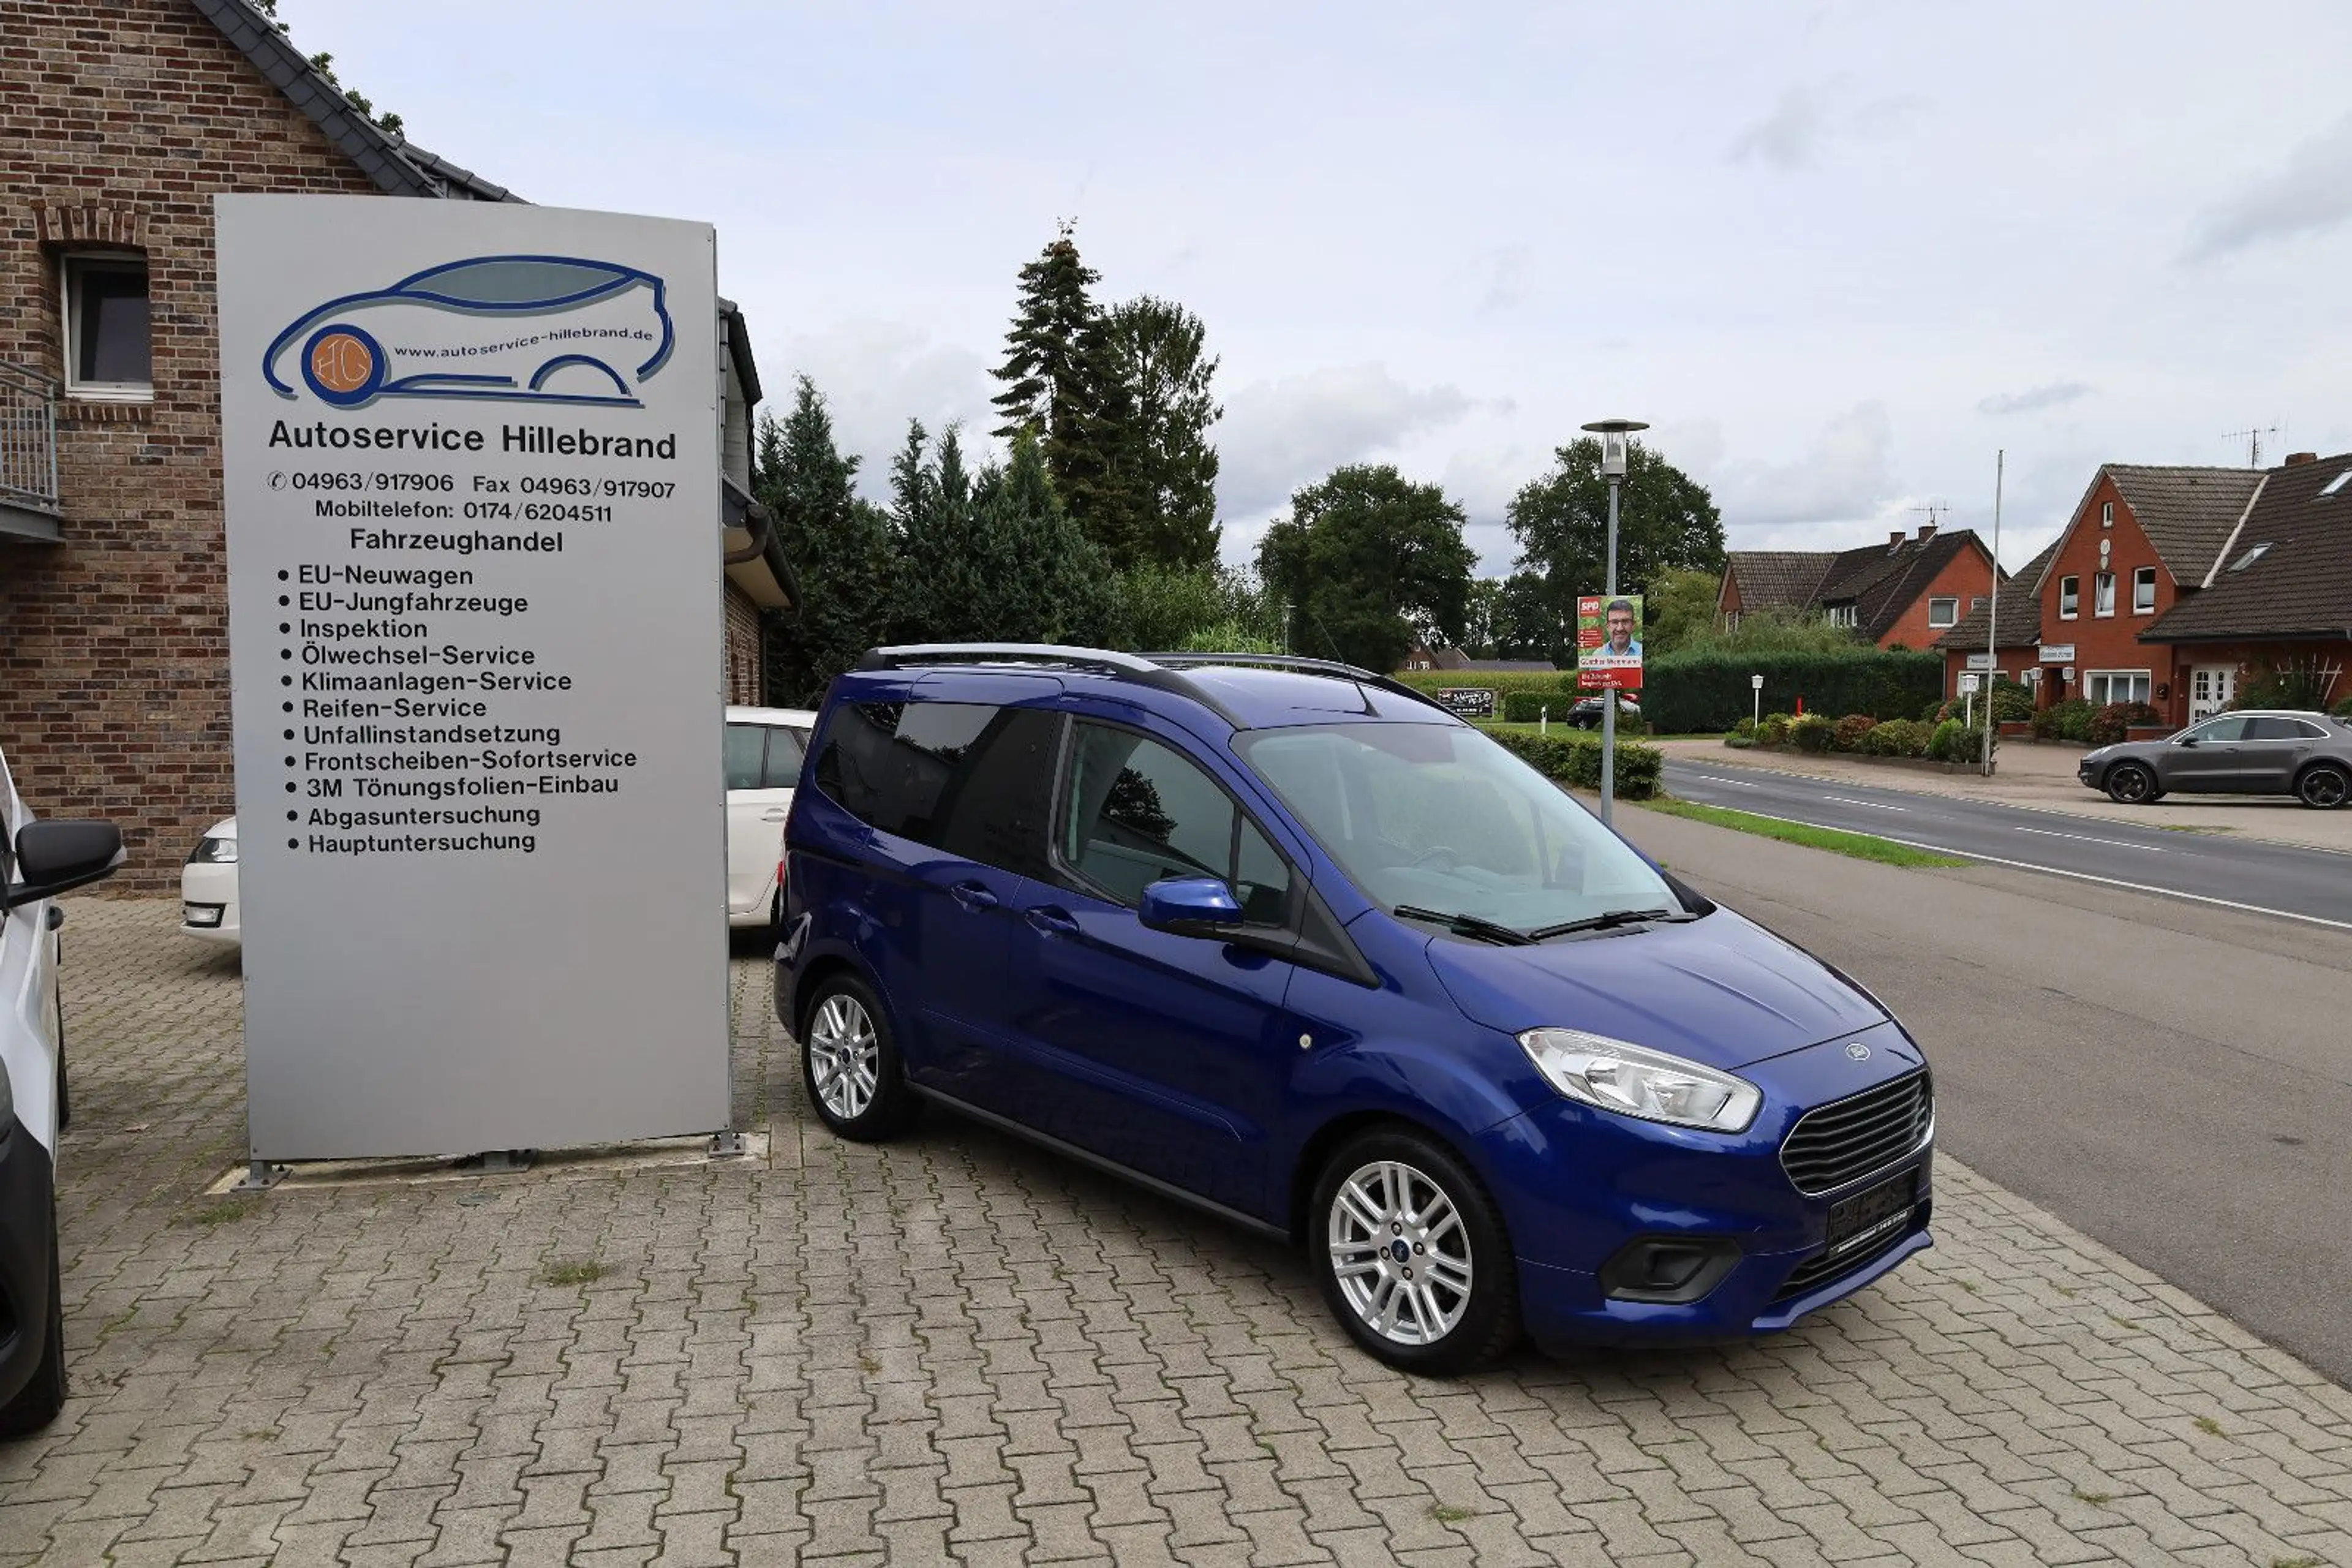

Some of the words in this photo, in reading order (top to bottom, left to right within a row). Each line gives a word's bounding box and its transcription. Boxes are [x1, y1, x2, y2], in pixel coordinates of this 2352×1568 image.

[393, 327, 654, 358] www.autoservice-hillebrand.de
[268, 420, 484, 451] Autoservice
[502, 424, 676, 461] Hillebrand
[292, 472, 454, 492] 04963/917906
[473, 475, 511, 493] Fax
[520, 477, 676, 499] 04963/917907
[315, 499, 454, 518] Mobiltelefon:
[463, 501, 611, 522] 0174/6204511
[350, 528, 563, 555] Fahrzeughandel
[298, 564, 473, 589] EU-Neuwagen
[300, 592, 529, 616] EU-Jungfahrzeuge
[1581, 601, 1599, 611] SPD
[301, 618, 428, 641] Inspektion
[301, 639, 536, 665] Ölwechsel-Service
[302, 671, 572, 693] Klimaanlagen-Service
[303, 698, 487, 718] Reifen-Service
[304, 724, 560, 747] Unfallinstandsetzung
[305, 748, 638, 771] Frontscheiben-Sofortservice
[307, 778, 342, 797] 3M
[352, 774, 619, 801] Tönungsfolien-Einbau
[308, 805, 541, 829] Abgasuntersuchung
[309, 831, 536, 855] Hauptuntersuchung
